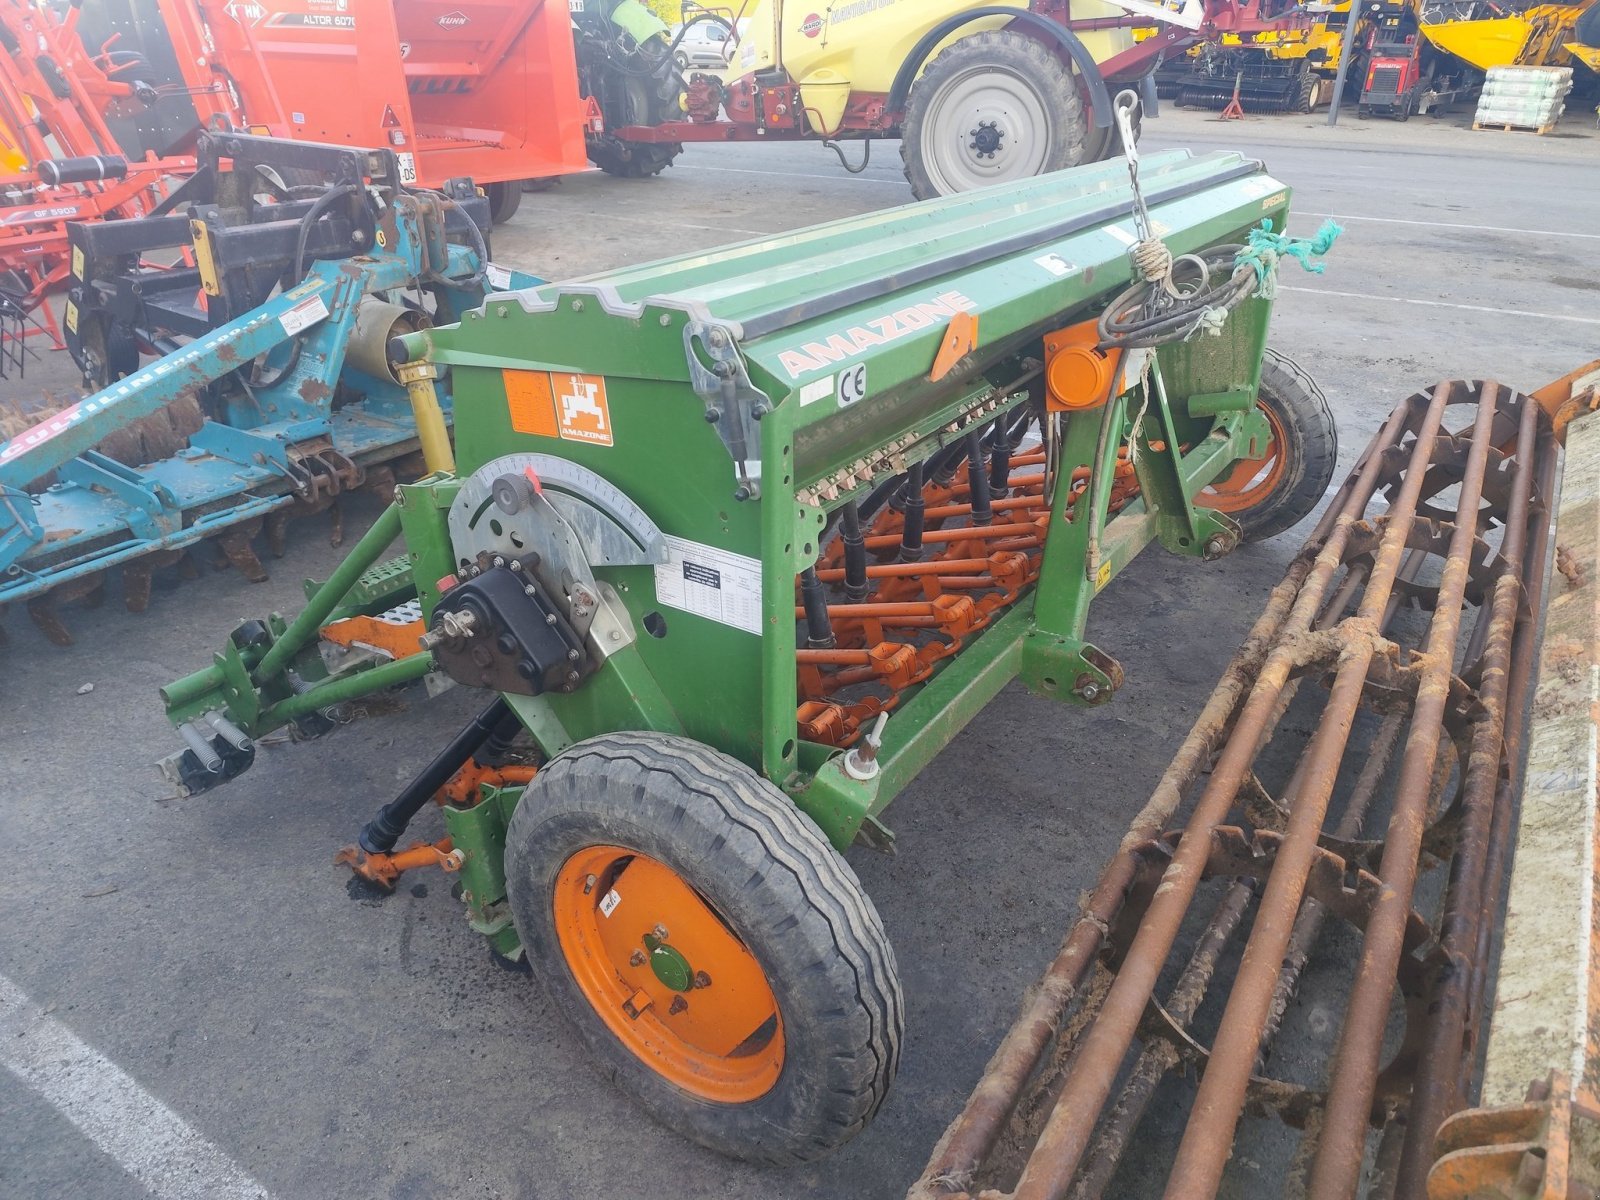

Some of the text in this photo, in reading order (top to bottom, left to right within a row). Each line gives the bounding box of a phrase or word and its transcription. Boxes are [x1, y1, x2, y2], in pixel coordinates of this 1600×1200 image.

[230, 4, 260, 18] KHN
[303, 15, 332, 25] ALTOR
[439, 17, 466, 25] KUHN
[803, 20, 822, 32] HARDI
[34, 206, 77, 218] GF 5903
[778, 290, 978, 379] AMAZONE
[841, 366, 865, 402] CE
[562, 427, 611, 442] AMAZONE
